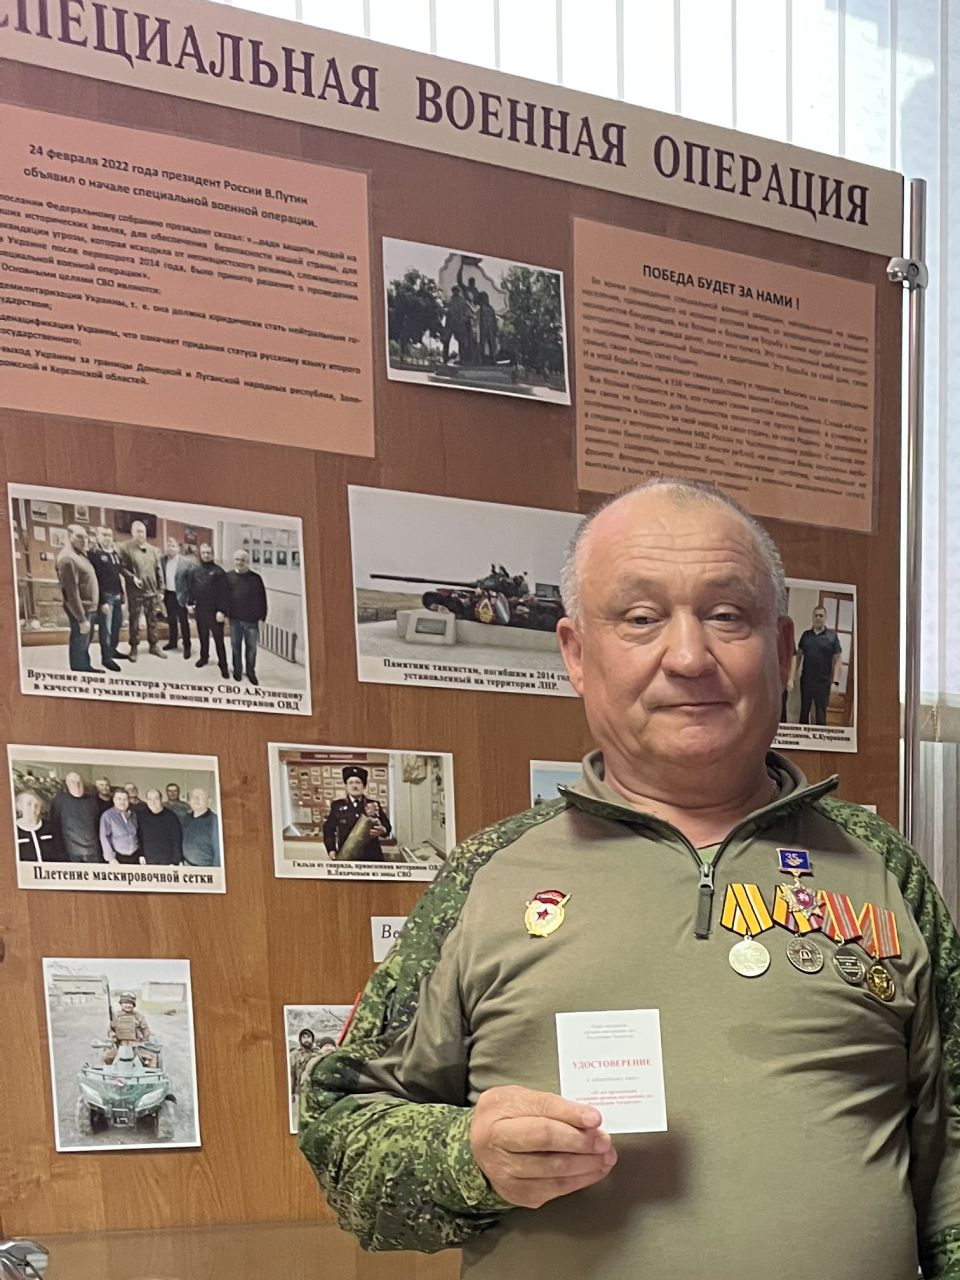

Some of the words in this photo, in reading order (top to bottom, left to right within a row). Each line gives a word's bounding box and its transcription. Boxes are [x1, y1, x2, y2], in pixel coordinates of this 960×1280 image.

[0, 0, 379, 111] ПЕЦИАЛЬНАЯ
[415, 76, 626, 167] ВОЕННАЯ
[653, 135, 869, 226] ОПЕРАЦИЯ
[29, 144, 43, 156] 24
[46, 148, 98, 167] февраля
[101, 157, 129, 172] 2022
[131, 164, 158, 177] года
[161, 169, 221, 188] президент
[224, 181, 262, 196] России
[264, 188, 308, 204] В.Путин
[23, 166, 75, 184] объявил
[78, 177, 86, 186] о
[88, 180, 130, 193] начале
[133, 186, 208, 207] специальной
[211, 202, 258, 217] военной
[261, 210, 318, 227] операции.
[643, 264, 695, 288] ПОБЕДА
[697, 276, 736, 296] БУДЕТ
[738, 284, 754, 299] ЗА
[756, 289, 792, 309] НАМИ
[383, 659, 430, 671] Памятник
[433, 664, 482, 676] танкистам,
[484, 667, 527, 679] погибшим
[537, 671, 555, 680] 2014
[404, 672, 471, 685] установленный
[474, 677, 484, 685] на
[487, 679, 536, 689] территории
[27, 669, 78, 681] Вручение
[82, 674, 105, 685] дрон
[108, 676, 160, 688] детектора
[163, 681, 214, 694] участнику
[218, 684, 241, 694] СВО
[244, 687, 303, 701] А.Кузнецову
[43, 683, 90, 693] качестве
[93, 686, 166, 699] гуманитарной
[170, 693, 209, 703] помощи
[226, 697, 275, 708] ветеранов
[277, 700, 300, 711] ОВД
[785, 853, 798, 861] 35
[33, 866, 89, 881] Плетение
[93, 870, 180, 885] маскировочной
[183, 873, 213, 884] сетки
[572, 1058, 651, 1070] УДОСТОВЕРЕНИЕ
